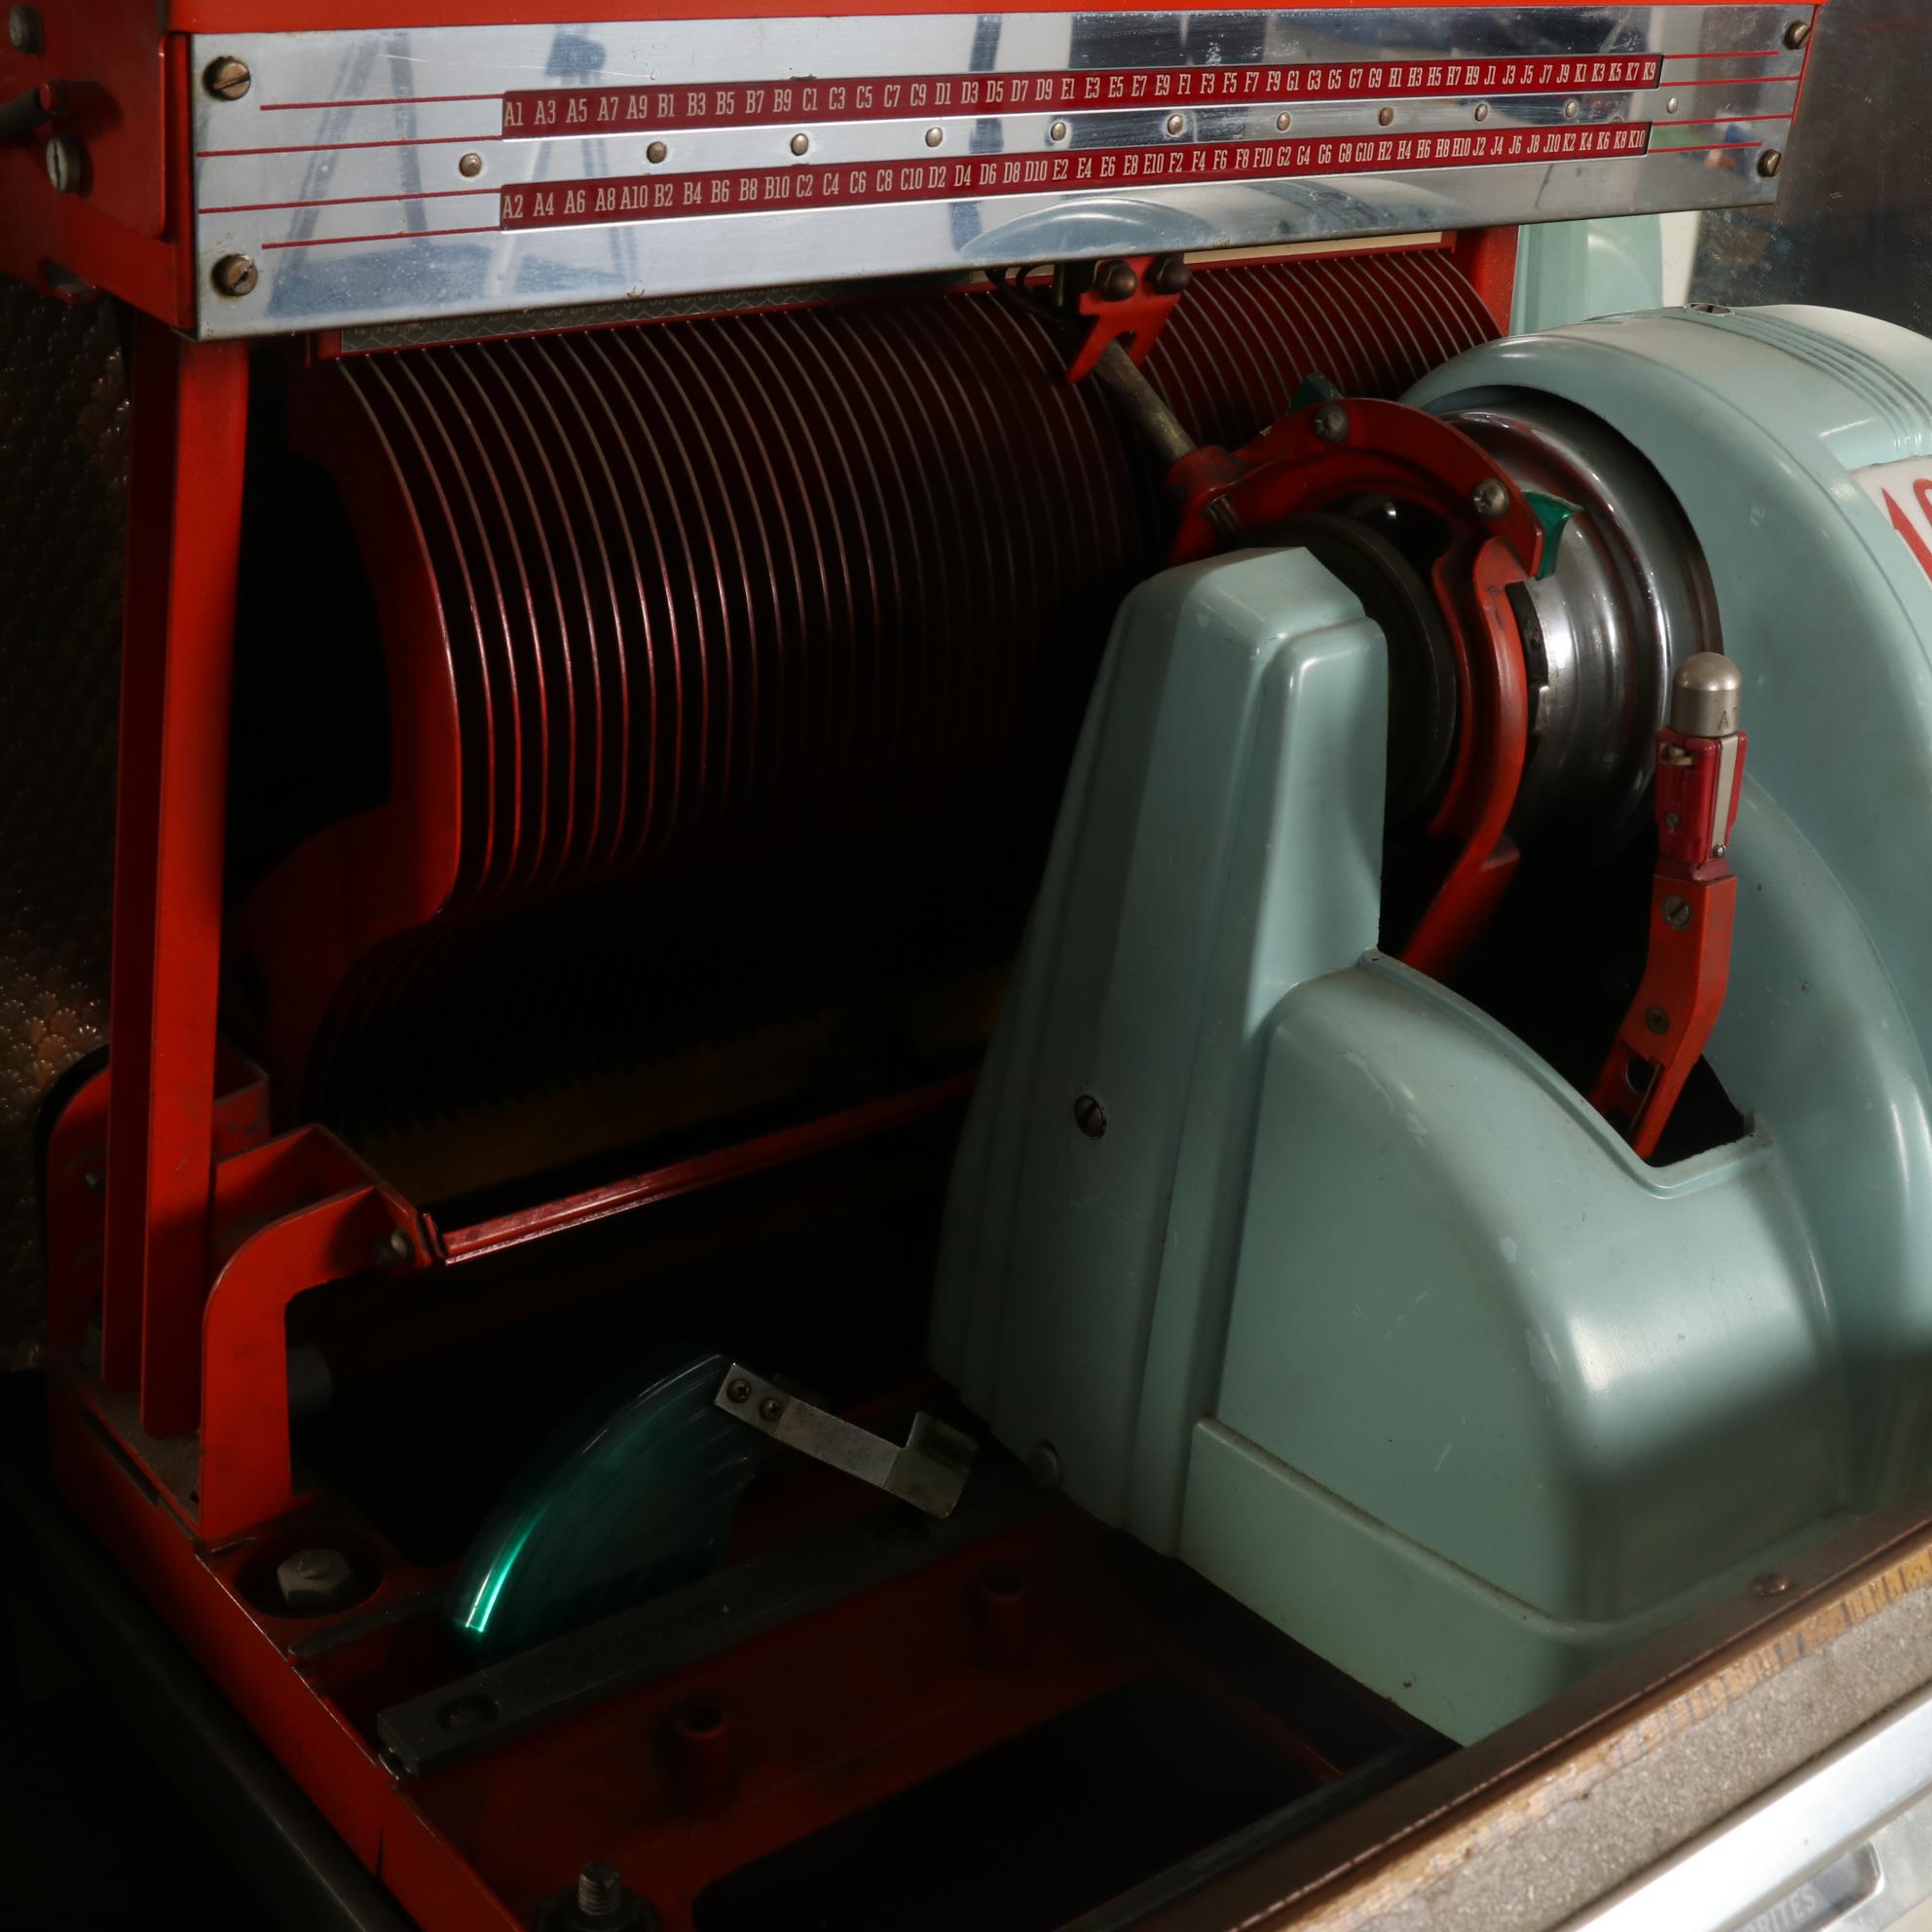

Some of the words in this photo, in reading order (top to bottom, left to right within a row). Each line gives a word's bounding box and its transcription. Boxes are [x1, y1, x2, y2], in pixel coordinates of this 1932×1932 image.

[503, 102, 524, 127] A1
[534, 99, 556, 125] A3
[566, 98, 587, 123] A5
[597, 96, 618, 121] A7
[626, 94, 648, 119] A9
[657, 93, 675, 118] B1
[687, 93, 706, 116] B3
[715, 92, 734, 115] B5
[745, 90, 764, 114] B7
[773, 89, 792, 112] B9
[802, 88, 818, 111] C1
[829, 87, 845, 110] C3
[856, 86, 873, 109] C5
[884, 85, 901, 107] C7
[910, 83, 927, 106] C9
[935, 83, 950, 105] D1
[960, 82, 979, 104] D3
[985, 80, 1004, 102] D5
[1010, 80, 1028, 101] D7
[1035, 79, 1053, 100] D9
[1060, 78, 1075, 99] E1
[1084, 77, 1100, 98] E3
[1108, 76, 1124, 97] E5
[1131, 75, 1147, 96] E7
[1154, 74, 1170, 95] E9
[1177, 73, 1191, 94] F1
[1200, 73, 1215, 93] F3
[1222, 72, 1238, 93] F5
[1244, 71, 1259, 93] F7
[1266, 71, 1282, 92] F9
[1286, 70, 1299, 92] G1
[1307, 70, 1321, 91] G3
[1327, 69, 1342, 90] G5
[1349, 68, 1363, 89] G7
[1368, 67, 1383, 88] G9
[1388, 67, 1402, 88] H1
[1407, 67, 1423, 87] H3
[1427, 66, 1442, 86] H5
[1446, 66, 1462, 86] H7
[1465, 65, 1480, 85] H9
[1484, 65, 1496, 85] J1
[1502, 65, 1516, 85] J3
[1520, 65, 1534, 84] J5
[1539, 64, 1553, 84] J7
[1556, 64, 1570, 84] J9
[1574, 63, 1587, 83] K1
[1591, 63, 1606, 82] K3
[1608, 62, 1622, 82] K5
[1625, 62, 1640, 81] K7
[1642, 61, 1656, 81] K9
[502, 195, 523, 219] A2
[533, 192, 554, 216] A4
[564, 190, 585, 214] A6
[594, 187, 615, 211] A8
[619, 185, 648, 209] A10
[653, 183, 673, 207] B2
[683, 181, 702, 204] B4
[710, 179, 730, 203] B6
[738, 178, 758, 201] B8
[763, 175, 790, 200] B10
[796, 174, 813, 198] C2
[823, 172, 839, 196] C4
[849, 170, 867, 194] C6
[876, 169, 893, 192] C8
[901, 167, 923, 191] C10
[928, 166, 947, 188] D2
[953, 165, 971, 187] D4
[979, 163, 997, 185] D6
[1002, 162, 1021, 183] D8
[1023, 160, 1048, 182] D10
[1052, 159, 1068, 180] E2
[1076, 158, 1092, 178] E4
[1099, 156, 1116, 177] E6
[1123, 155, 1138, 175] E8
[1142, 153, 1165, 174] E10
[1168, 152, 1184, 173] F2
[1191, 151, 1206, 172] F4
[1212, 150, 1228, 170] F6
[1235, 148, 1249, 169] F8
[1252, 147, 1273, 167] F10
[1277, 146, 1291, 167] G2
[1297, 145, 1311, 166] G4
[1318, 144, 1332, 164] G6
[1338, 143, 1353, 163] G8
[1356, 142, 1374, 162] G10
[1377, 141, 1393, 161] H2
[1396, 140, 1412, 160] H4
[1416, 139, 1431, 159] H6
[1434, 138, 1450, 158] H8
[1451, 137, 1471, 157] H10
[1472, 136, 1486, 156] J2
[1491, 136, 1504, 155] J4
[1508, 135, 1523, 154] J6
[1527, 134, 1541, 154] J8
[1543, 133, 1561, 153] J10
[1562, 133, 1577, 152] K2
[1579, 132, 1593, 151] K4
[1596, 131, 1611, 150] K6
[1613, 130, 1627, 149] K8
[1627, 130, 1646, 148] K10
